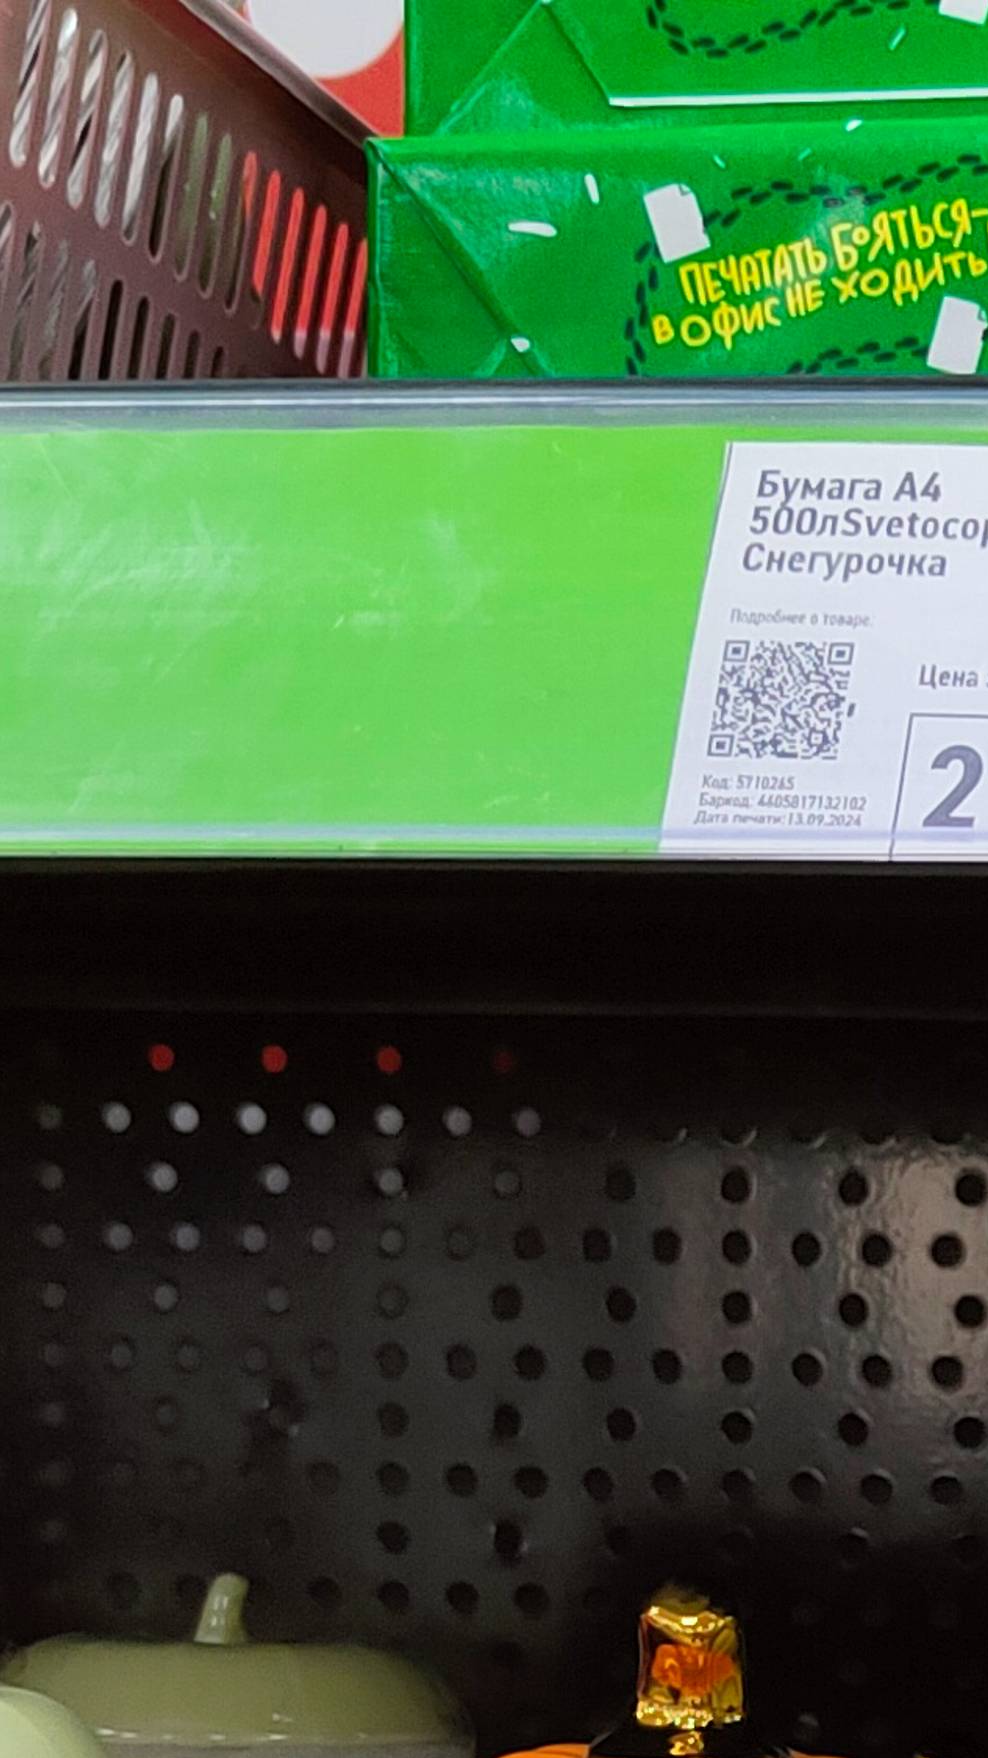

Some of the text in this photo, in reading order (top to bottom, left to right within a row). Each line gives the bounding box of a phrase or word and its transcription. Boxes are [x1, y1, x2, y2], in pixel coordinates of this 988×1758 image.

[679, 237, 828, 306] ПЕЧАТАТЬ
[680, 297, 781, 350] ОФИС
[786, 279, 826, 318] НЕ
[756, 469, 942, 508] Бумага А4
[741, 542, 947, 582] Снегурочка
[730, 607, 805, 627] Подробнее
[810, 614, 819, 625] о
[918, 663, 979, 691] Цена
[702, 774, 795, 791] Код: 5710265
[699, 792, 867, 811] Баркод: 4605817132102
[694, 811, 729, 826] Дата
